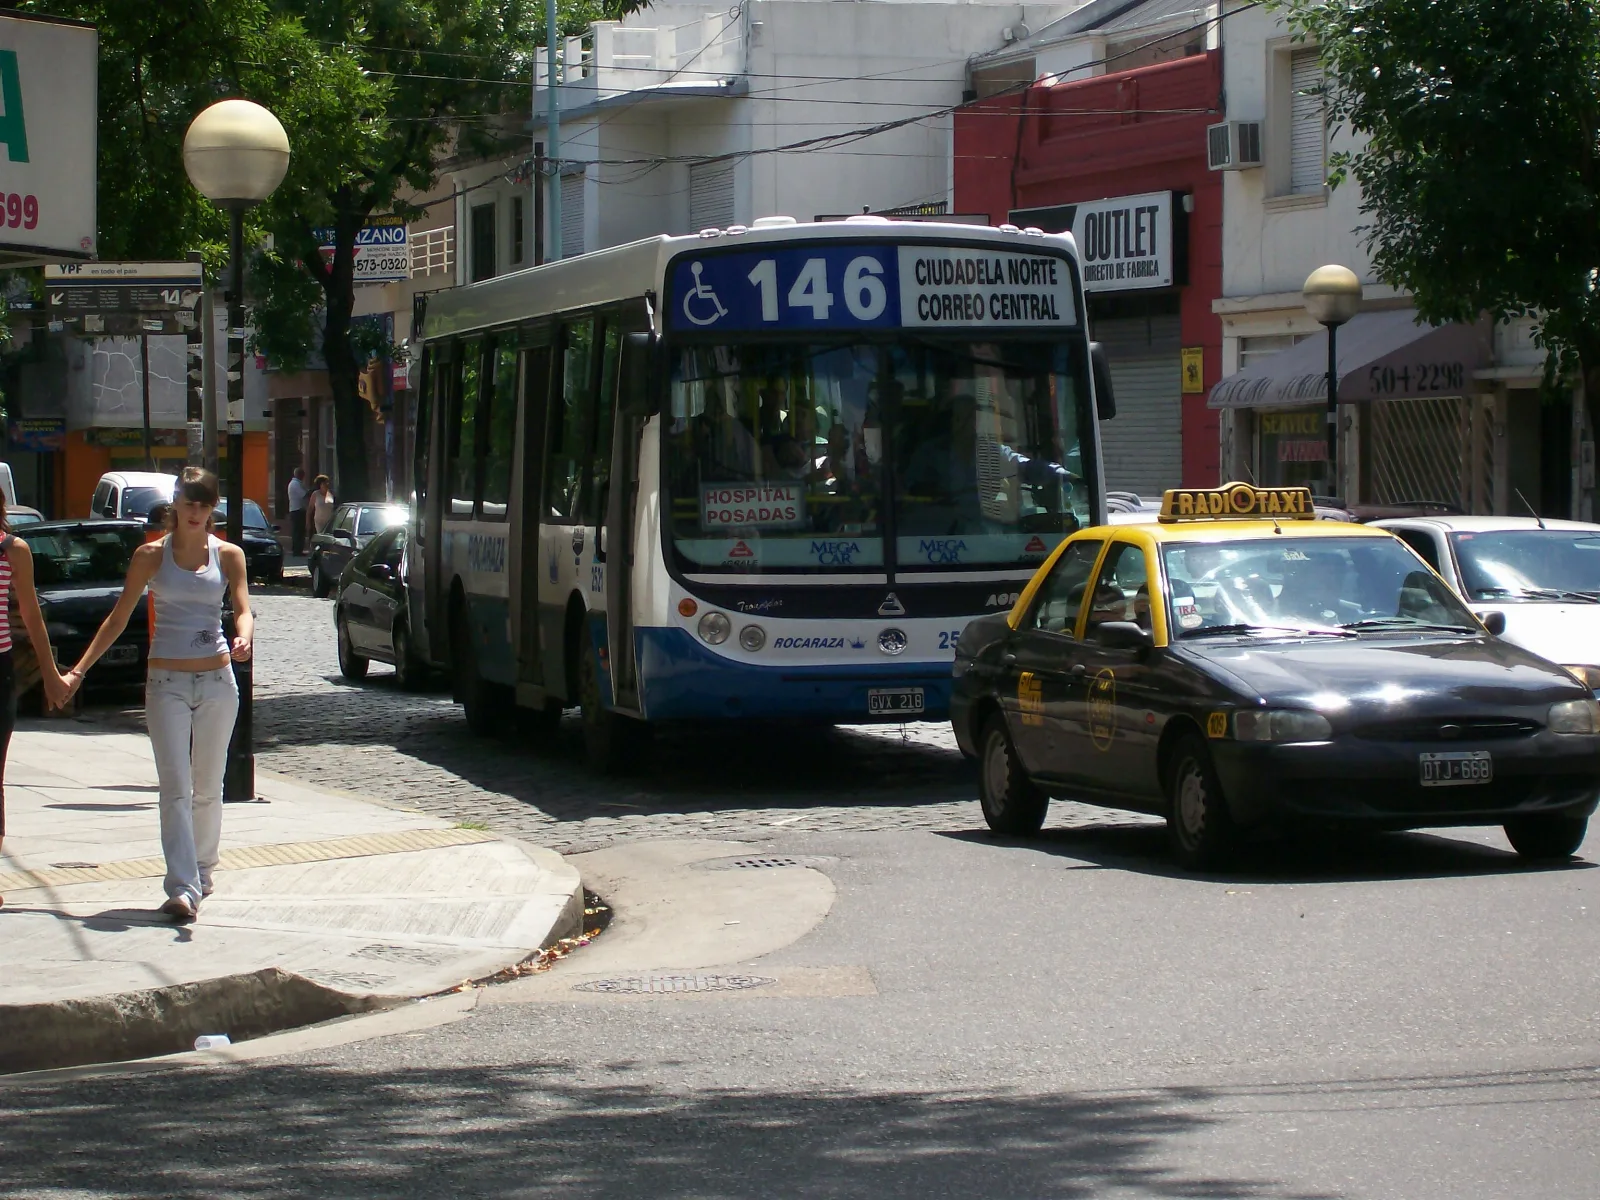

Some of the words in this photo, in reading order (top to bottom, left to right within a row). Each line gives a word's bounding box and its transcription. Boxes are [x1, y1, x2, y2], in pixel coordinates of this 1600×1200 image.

[1085, 205, 1159, 262] OUTLET
[60, 264, 83, 275] YPF
[915, 258, 1004, 286] CIUDADELA
[1008, 259, 1058, 285] NORTE
[1084, 264, 1114, 281] DIRECTO
[1116, 262, 1125, 279] DE
[1127, 260, 1159, 278] FABRICA
[747, 256, 887, 321] 146
[917, 293, 985, 321] CORREO
[989, 294, 1059, 320] CENTRAL
[1262, 413, 1320, 434] SERVICE
[705, 488, 796, 504] HOSPITAL
[1255, 491, 1305, 513] TAXI
[707, 507, 797, 523] POSADAS
[809, 541, 861, 554] MEGA
[919, 540, 969, 552] MEGA
[819, 552, 853, 565] CAR
[928, 551, 962, 563] CAR
[774, 637, 845, 649] ROCARAZA
[871, 695, 892, 709] GVX
[1424, 762, 1451, 779] DTJ
